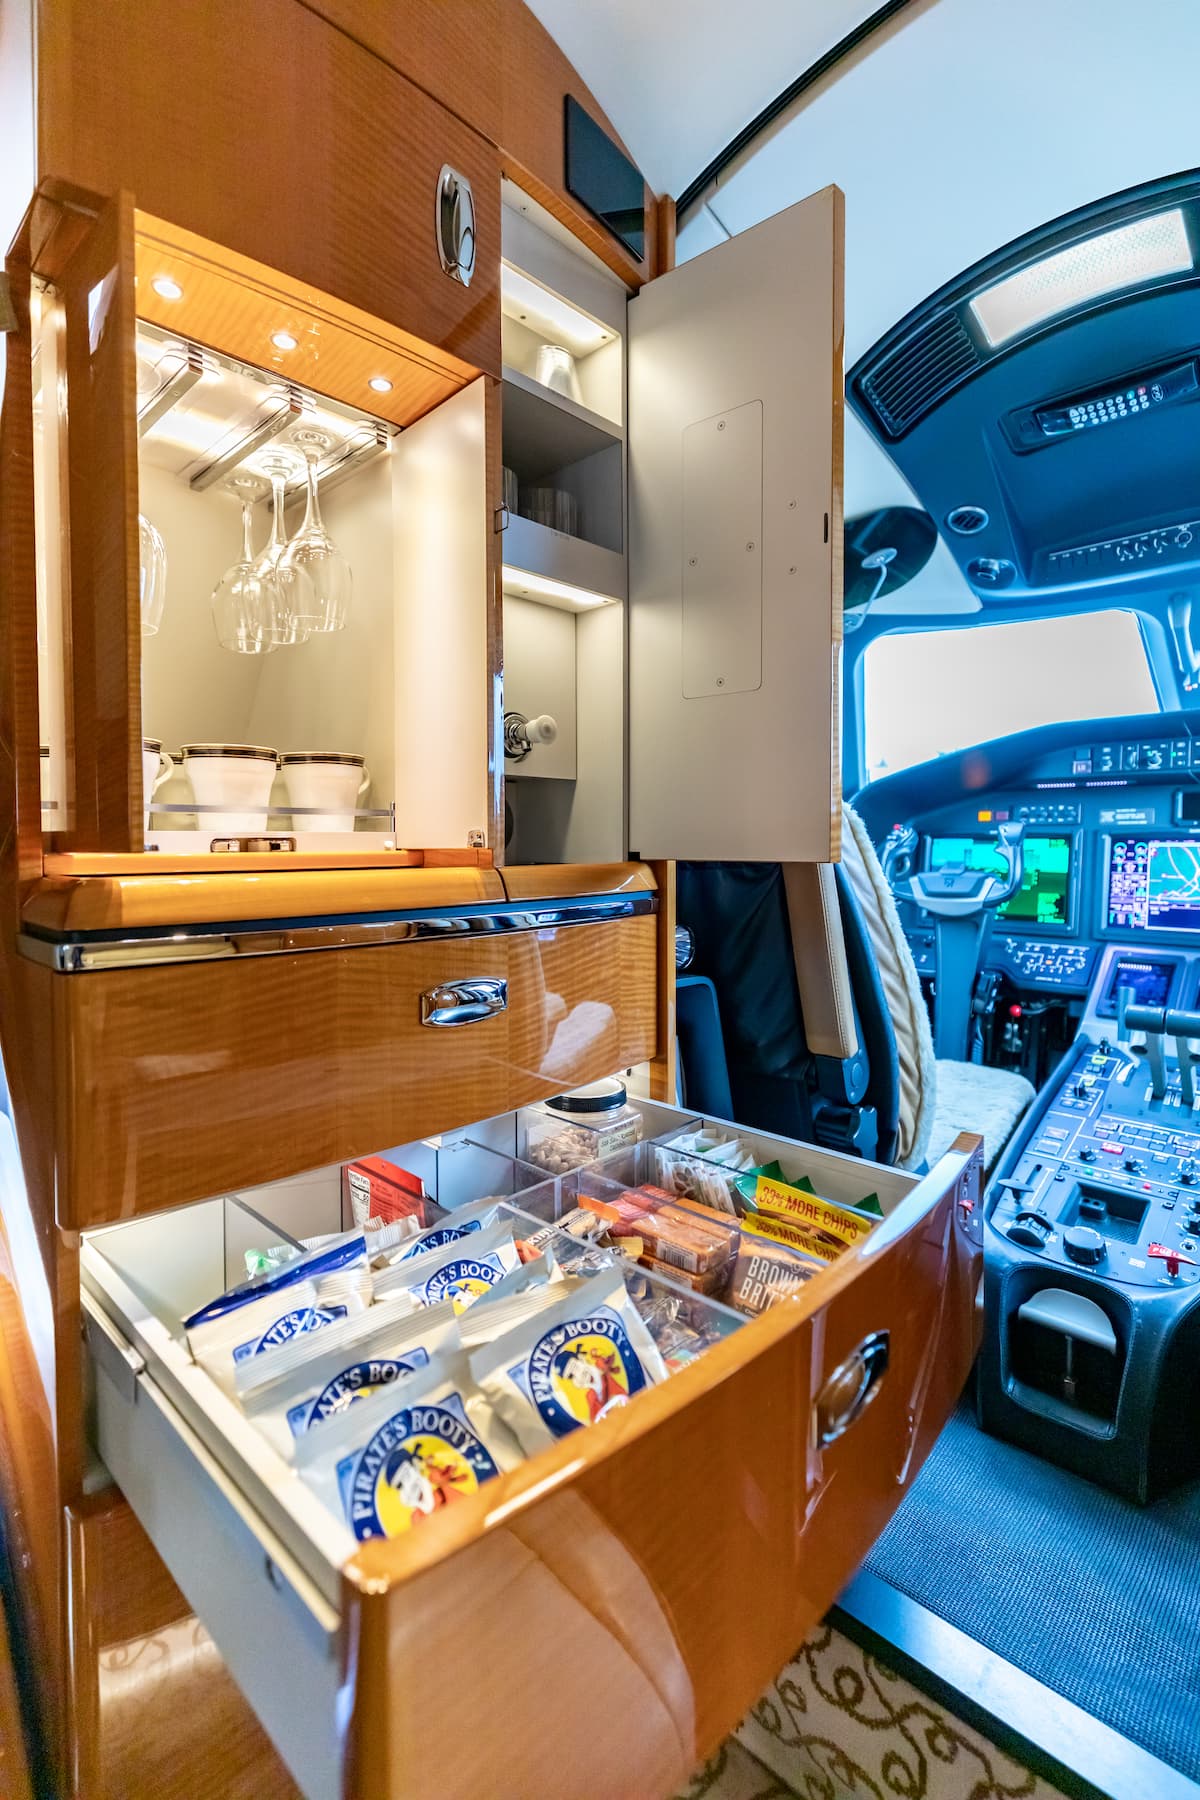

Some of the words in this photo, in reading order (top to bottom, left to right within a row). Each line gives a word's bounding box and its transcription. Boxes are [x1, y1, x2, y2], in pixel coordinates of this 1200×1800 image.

[784, 1195, 821, 1221] MORE
[823, 1210, 859, 1240] CHIPS
[777, 1227, 812, 1252] MORE
[564, 1318, 627, 1347] BOOTY
[353, 1415, 408, 1520] PIRATE'S
[411, 1408, 477, 1456] BOOTY
